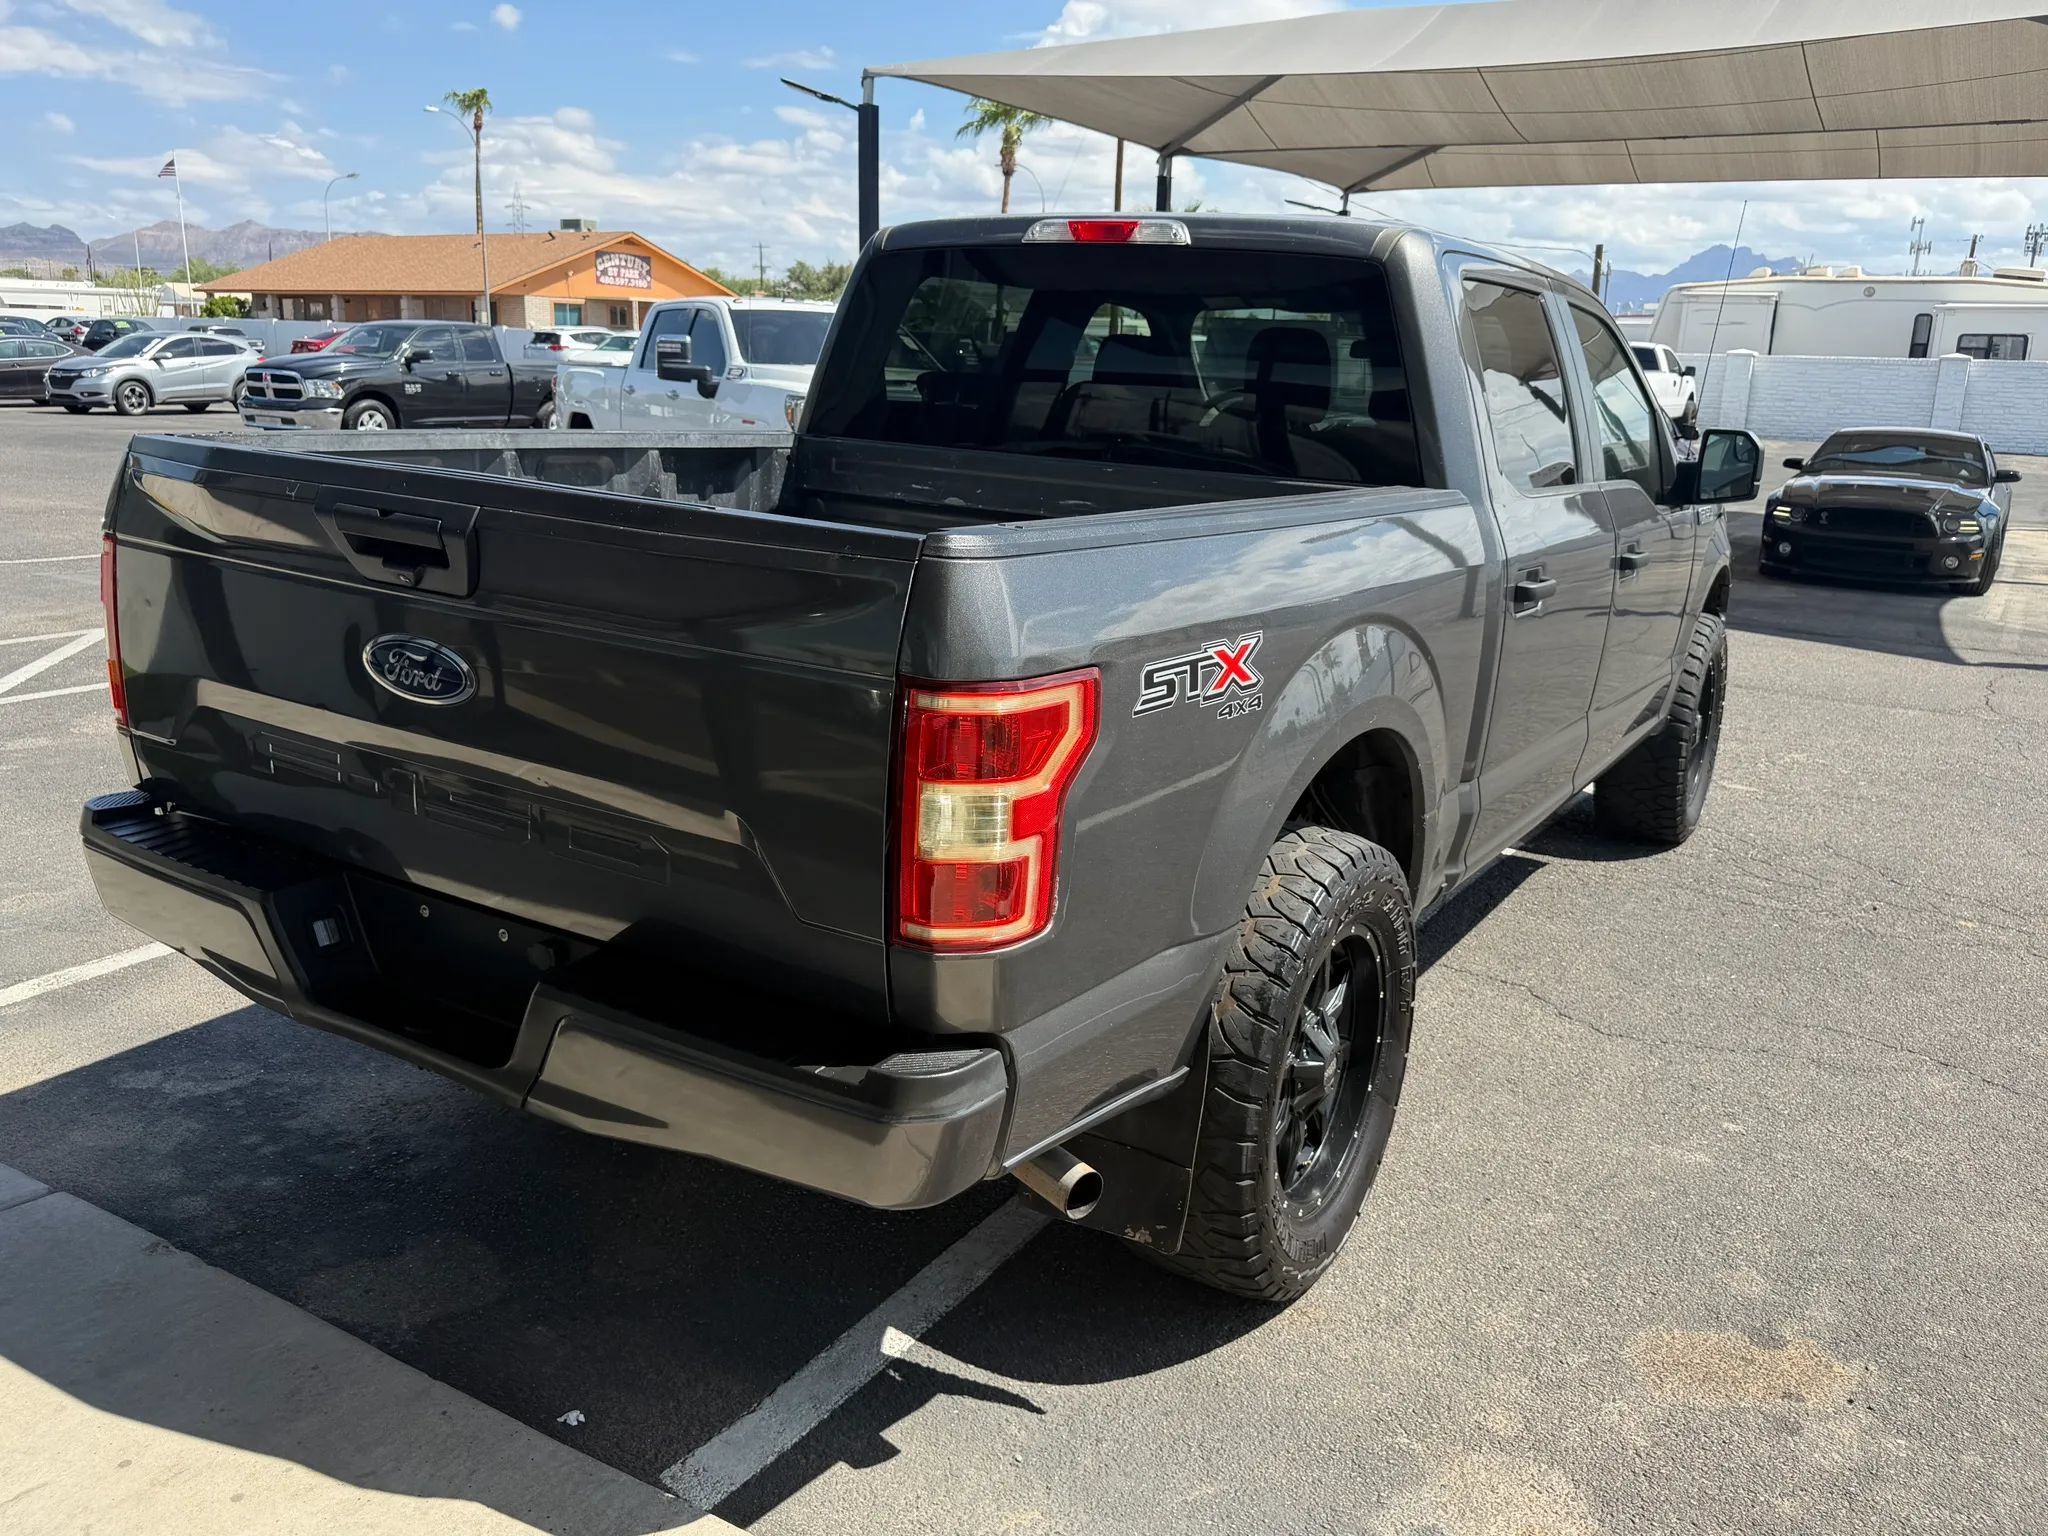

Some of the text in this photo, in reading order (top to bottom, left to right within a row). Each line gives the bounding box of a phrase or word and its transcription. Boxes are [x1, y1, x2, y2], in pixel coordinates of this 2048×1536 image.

[596, 253, 650, 276] CENTURY
[607, 266, 640, 279] RV PARK
[384, 648, 442, 692] Ford
[1132, 630, 1264, 718] STX
